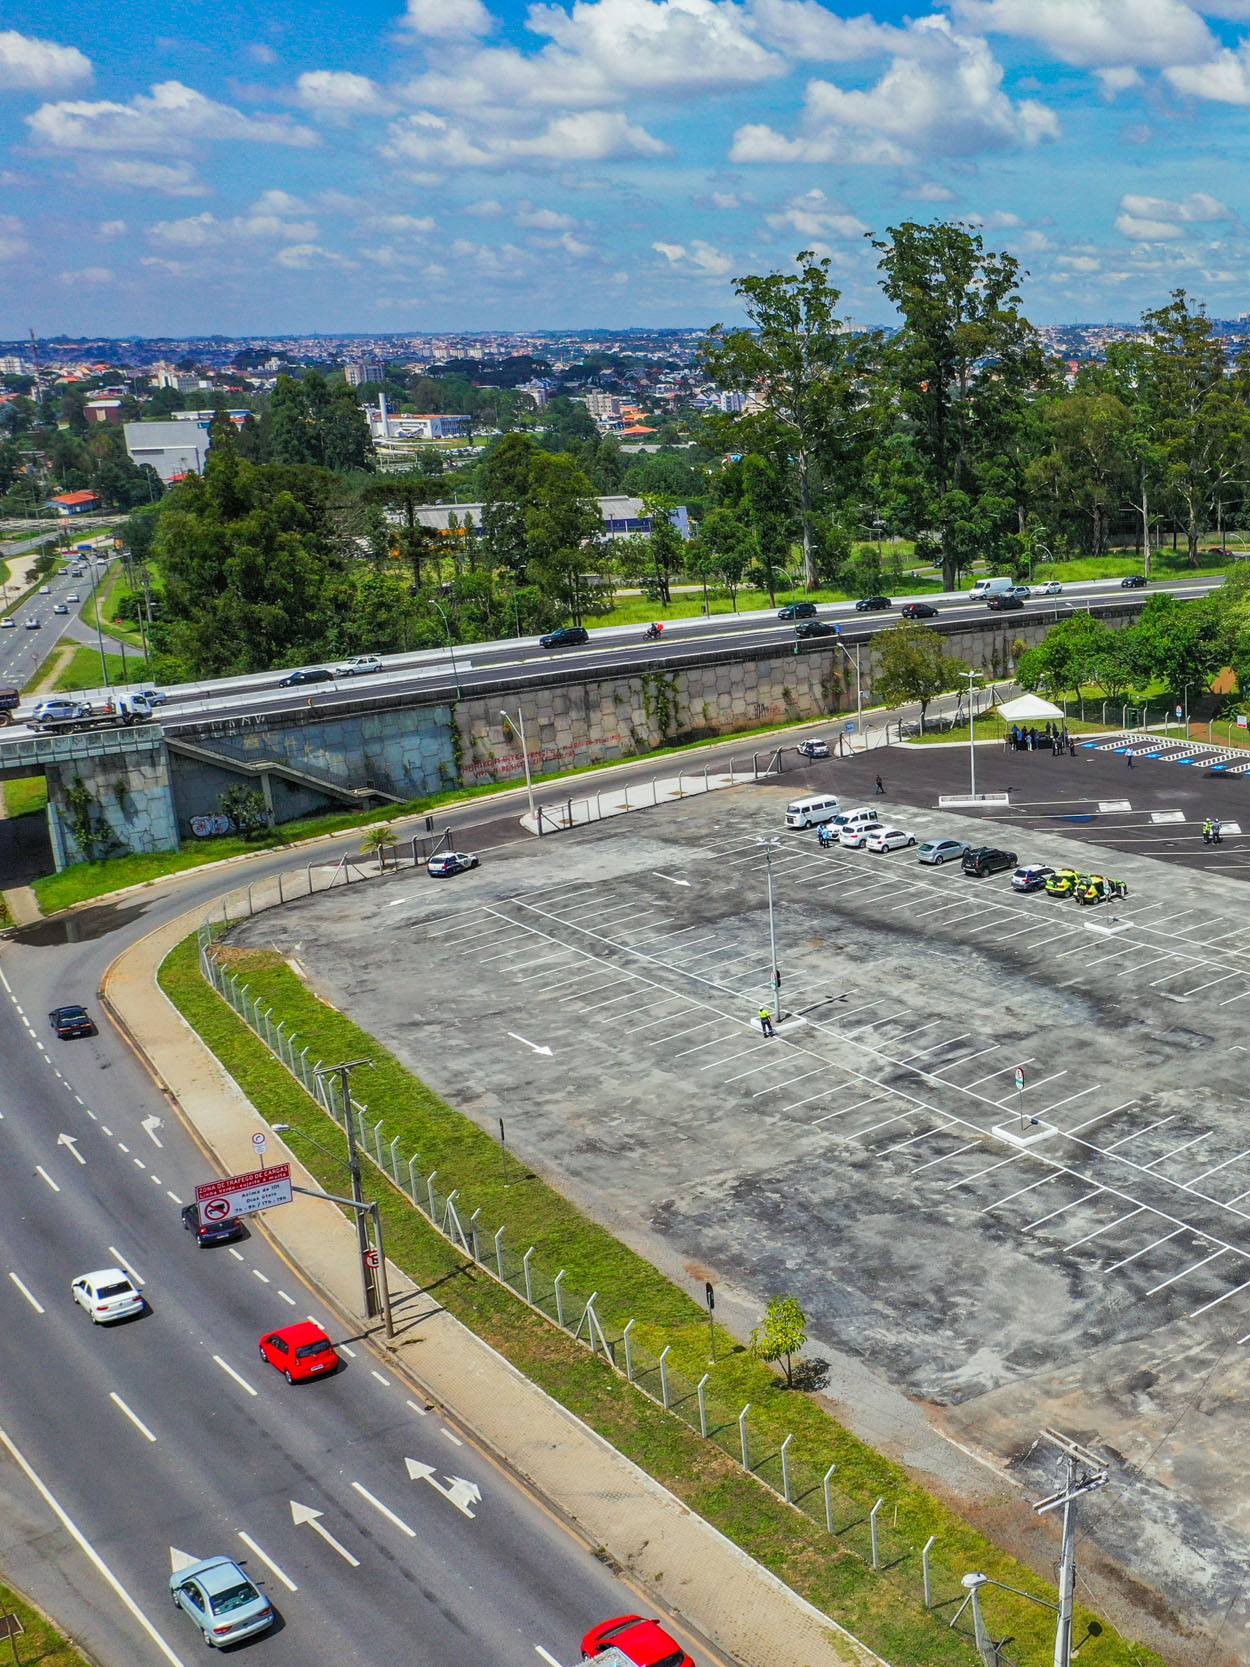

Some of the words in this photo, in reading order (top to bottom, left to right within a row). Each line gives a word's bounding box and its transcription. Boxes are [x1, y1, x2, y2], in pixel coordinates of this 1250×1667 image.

[198, 1185, 216, 1194] ZONA
[263, 1166, 288, 1176] CARGAS
[241, 1190, 260, 1198] Acima
